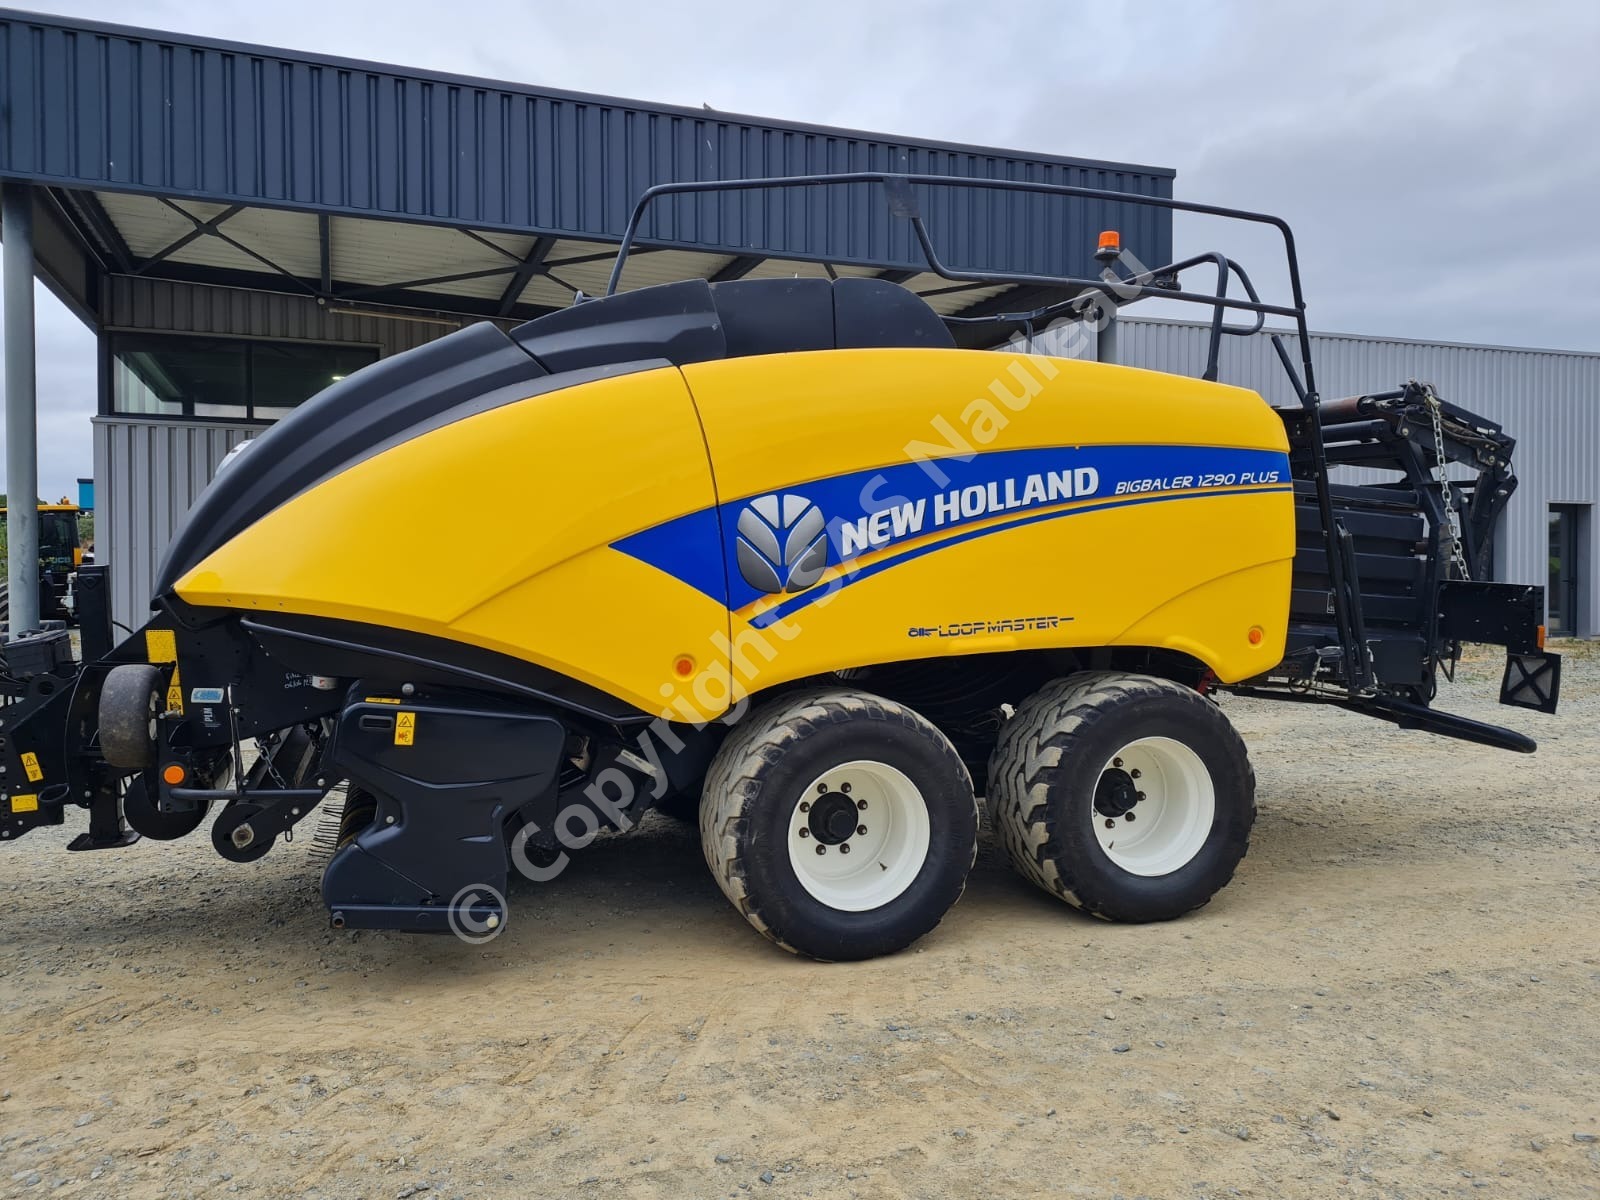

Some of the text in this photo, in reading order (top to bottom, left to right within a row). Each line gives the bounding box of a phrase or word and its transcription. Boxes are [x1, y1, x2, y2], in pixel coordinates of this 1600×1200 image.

[1115, 471, 1279, 495] BIGBALER 1290 PLUS
[841, 466, 1099, 556] NEW HOLLAND
[202, 707, 213, 722] PLM
